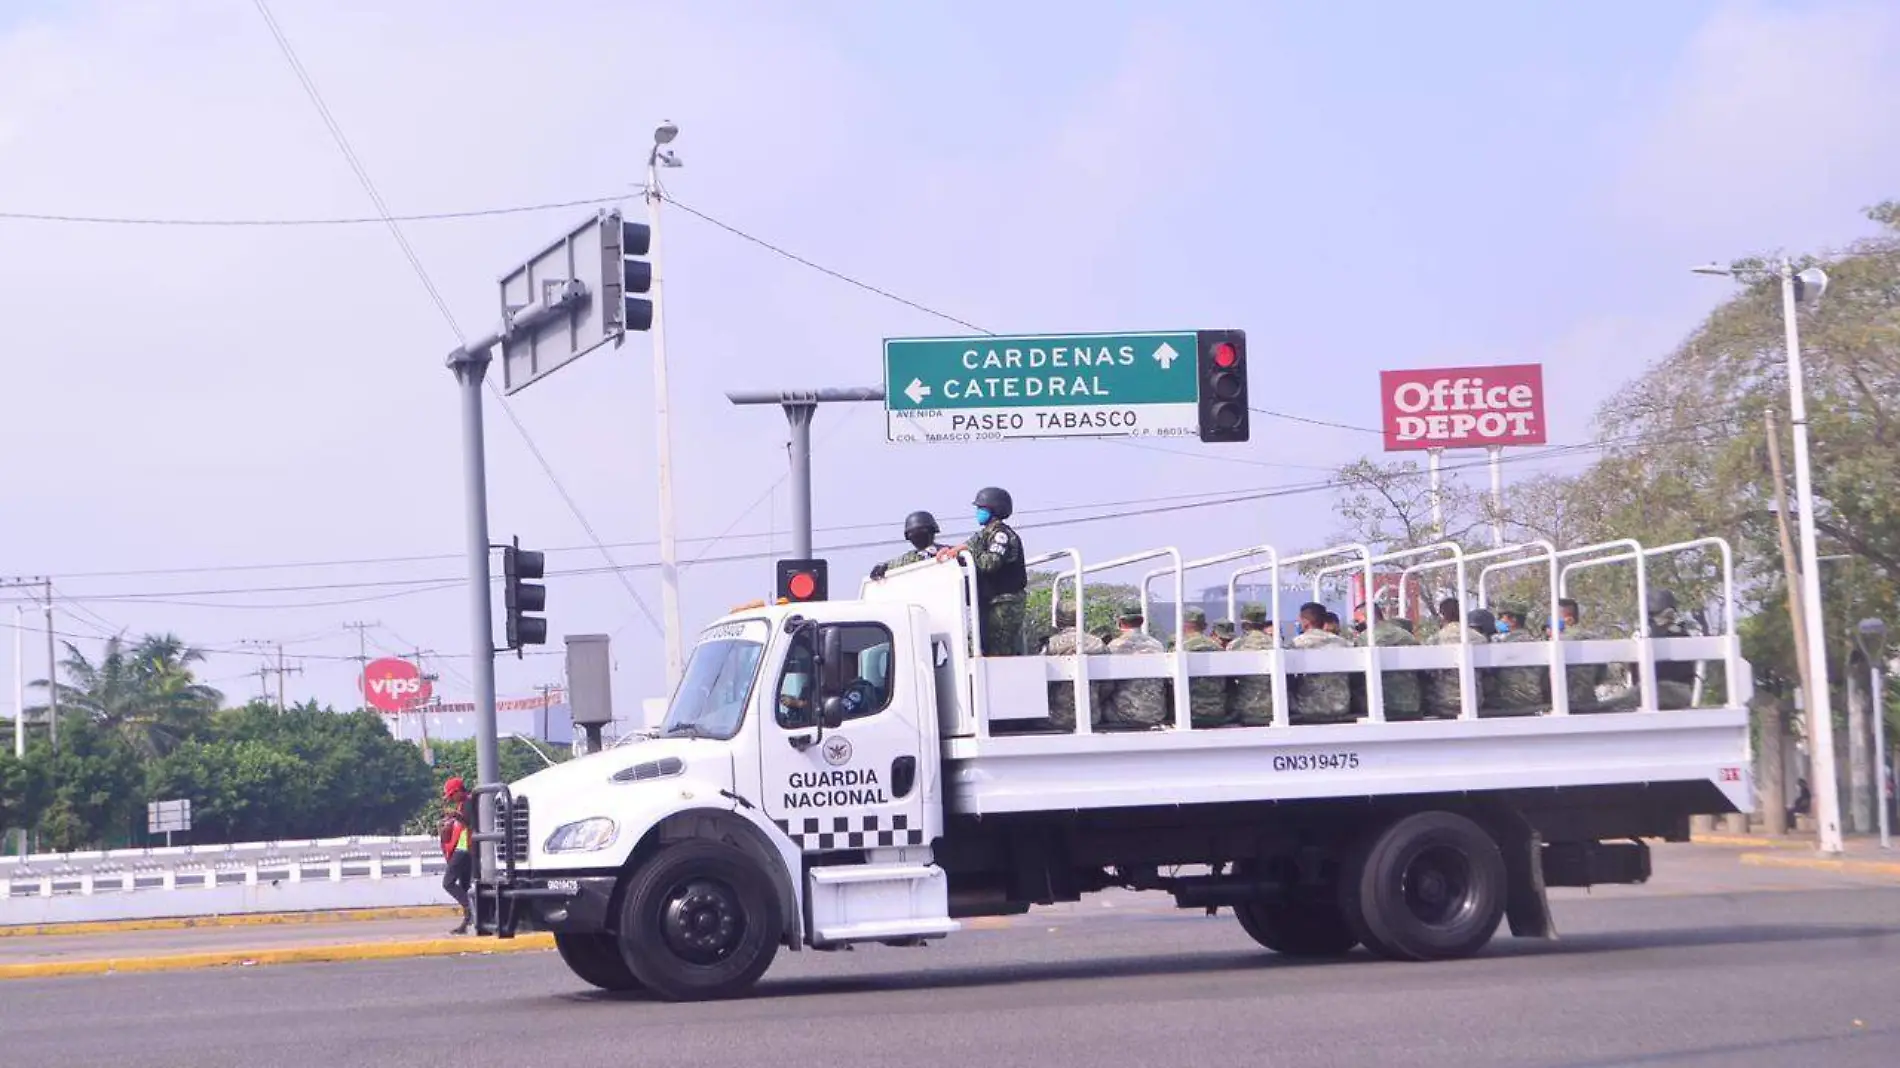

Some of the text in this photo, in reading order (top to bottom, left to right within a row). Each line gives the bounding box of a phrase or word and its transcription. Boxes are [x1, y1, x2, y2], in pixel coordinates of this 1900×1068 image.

[962, 346, 1135, 370] CARDENAS
[943, 377, 1109, 399] CATEDRAL
[1393, 378, 1533, 413] Office
[896, 410, 943, 418] AVENIDA
[952, 411, 1136, 430] PASEO TABASCO
[926, 433, 970, 441] TABASCO
[976, 432, 1002, 440] 2000
[368, 673, 420, 700] vips
[1273, 753, 1359, 771] GN319475
[789, 769, 878, 788] GUARDIA
[784, 789, 888, 809] NACIONAL
